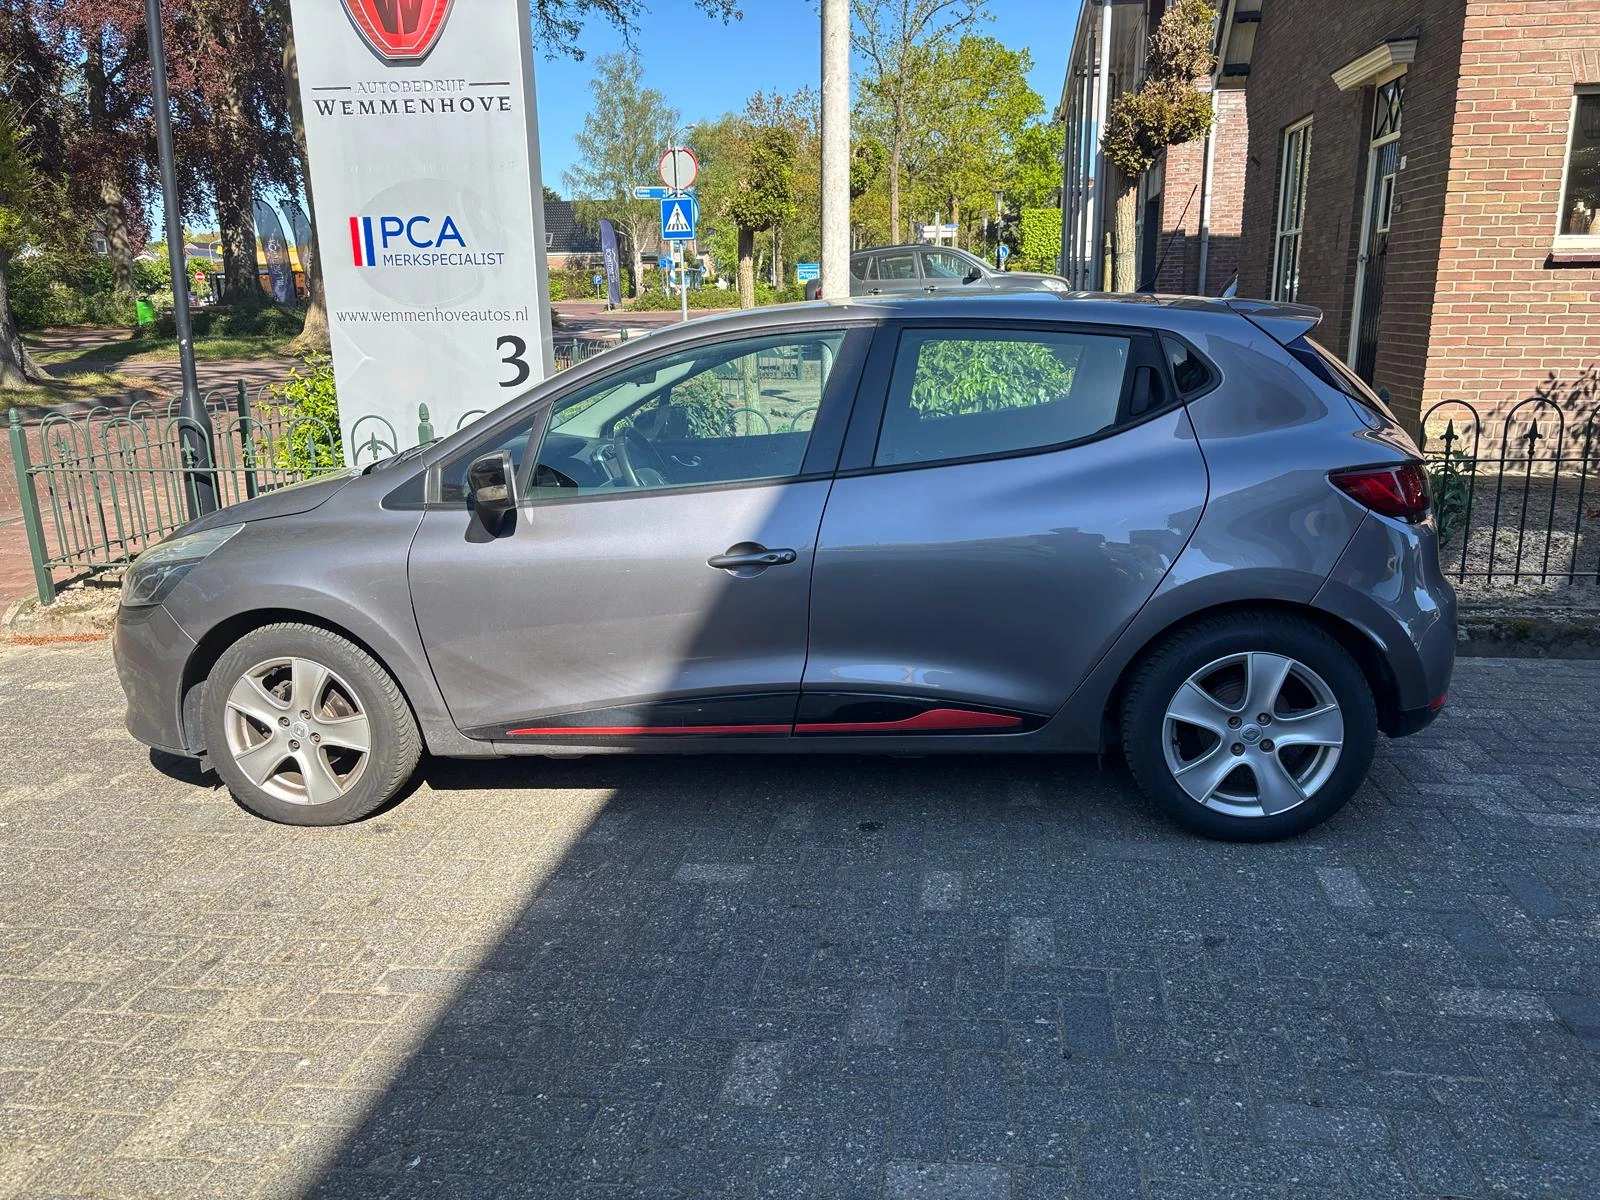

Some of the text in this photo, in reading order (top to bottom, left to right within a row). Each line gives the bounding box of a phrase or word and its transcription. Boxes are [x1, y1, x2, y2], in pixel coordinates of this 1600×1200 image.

[356, 79, 466, 94] AUTOBEDRIJF
[313, 96, 511, 116] WEMMENHOVE
[380, 215, 466, 248] PCA
[383, 252, 505, 267] MERKSPECIALIST
[336, 306, 529, 322] www.wemmenhoveautos.nl
[496, 335, 531, 388] 3
